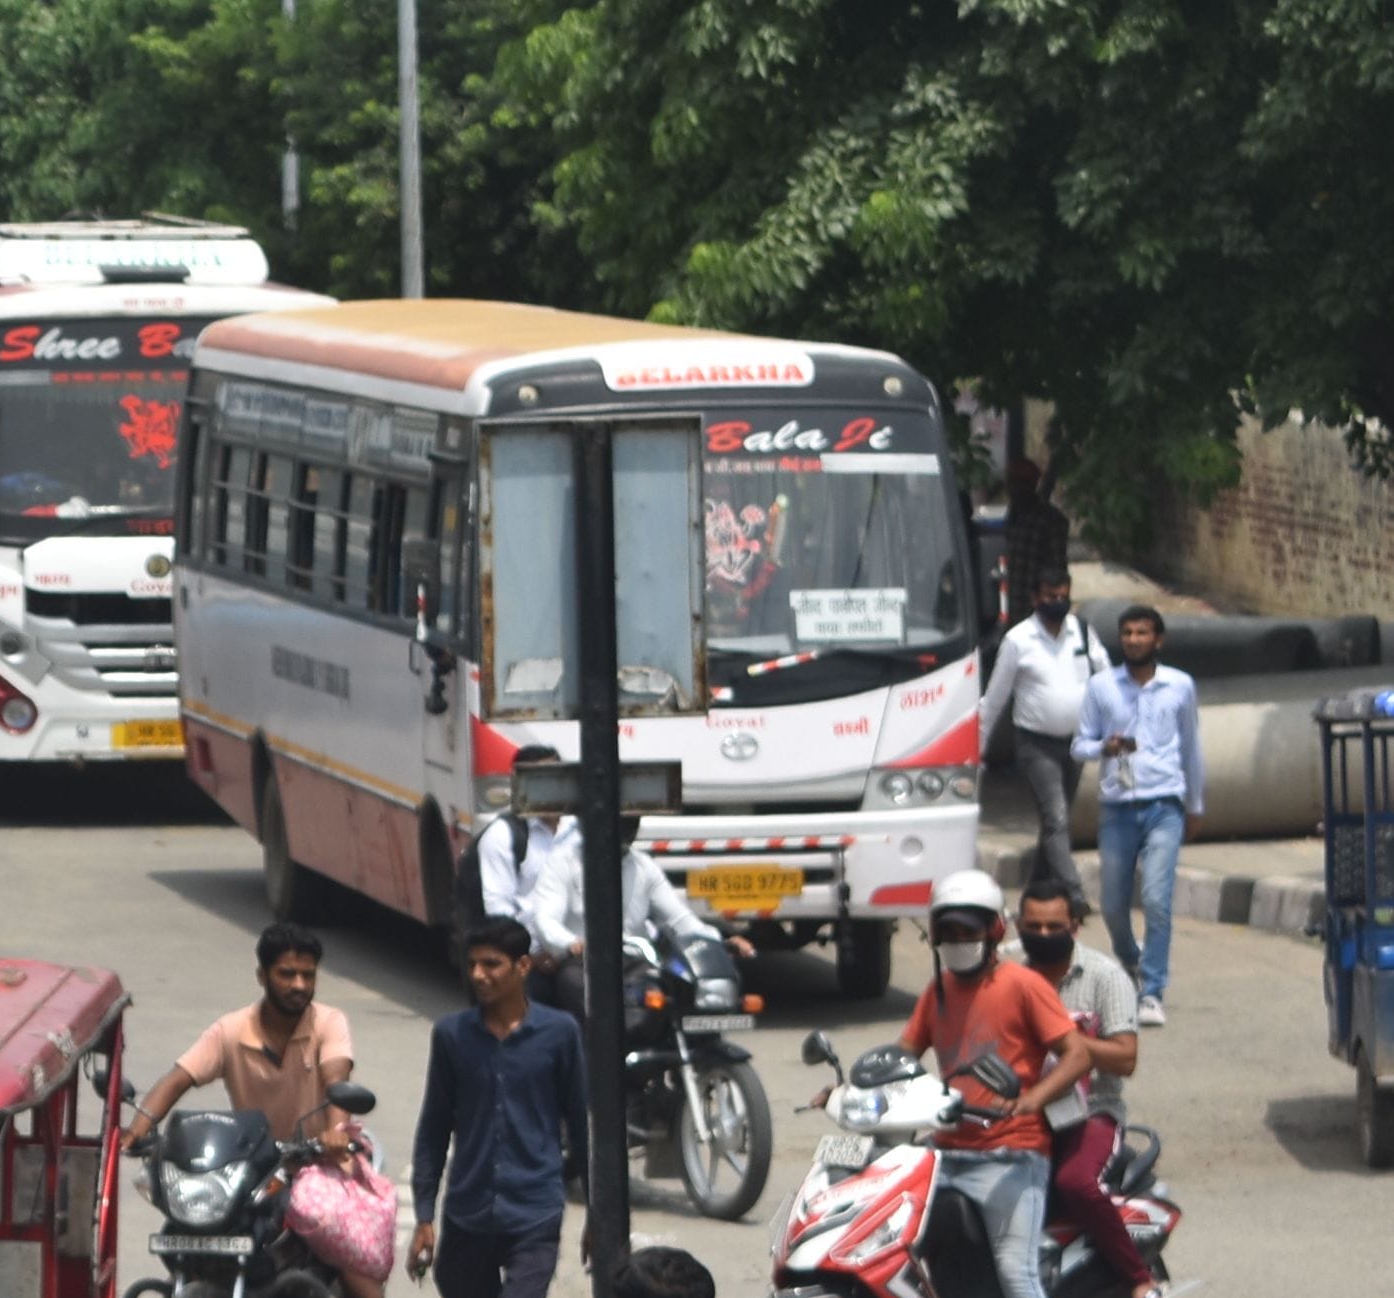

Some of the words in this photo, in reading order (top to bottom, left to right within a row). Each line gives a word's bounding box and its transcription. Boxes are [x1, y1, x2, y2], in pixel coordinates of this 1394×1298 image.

[705, 419, 828, 453] Bala
[833, 416, 894, 452] Ji
[698, 875, 717, 893] HR
